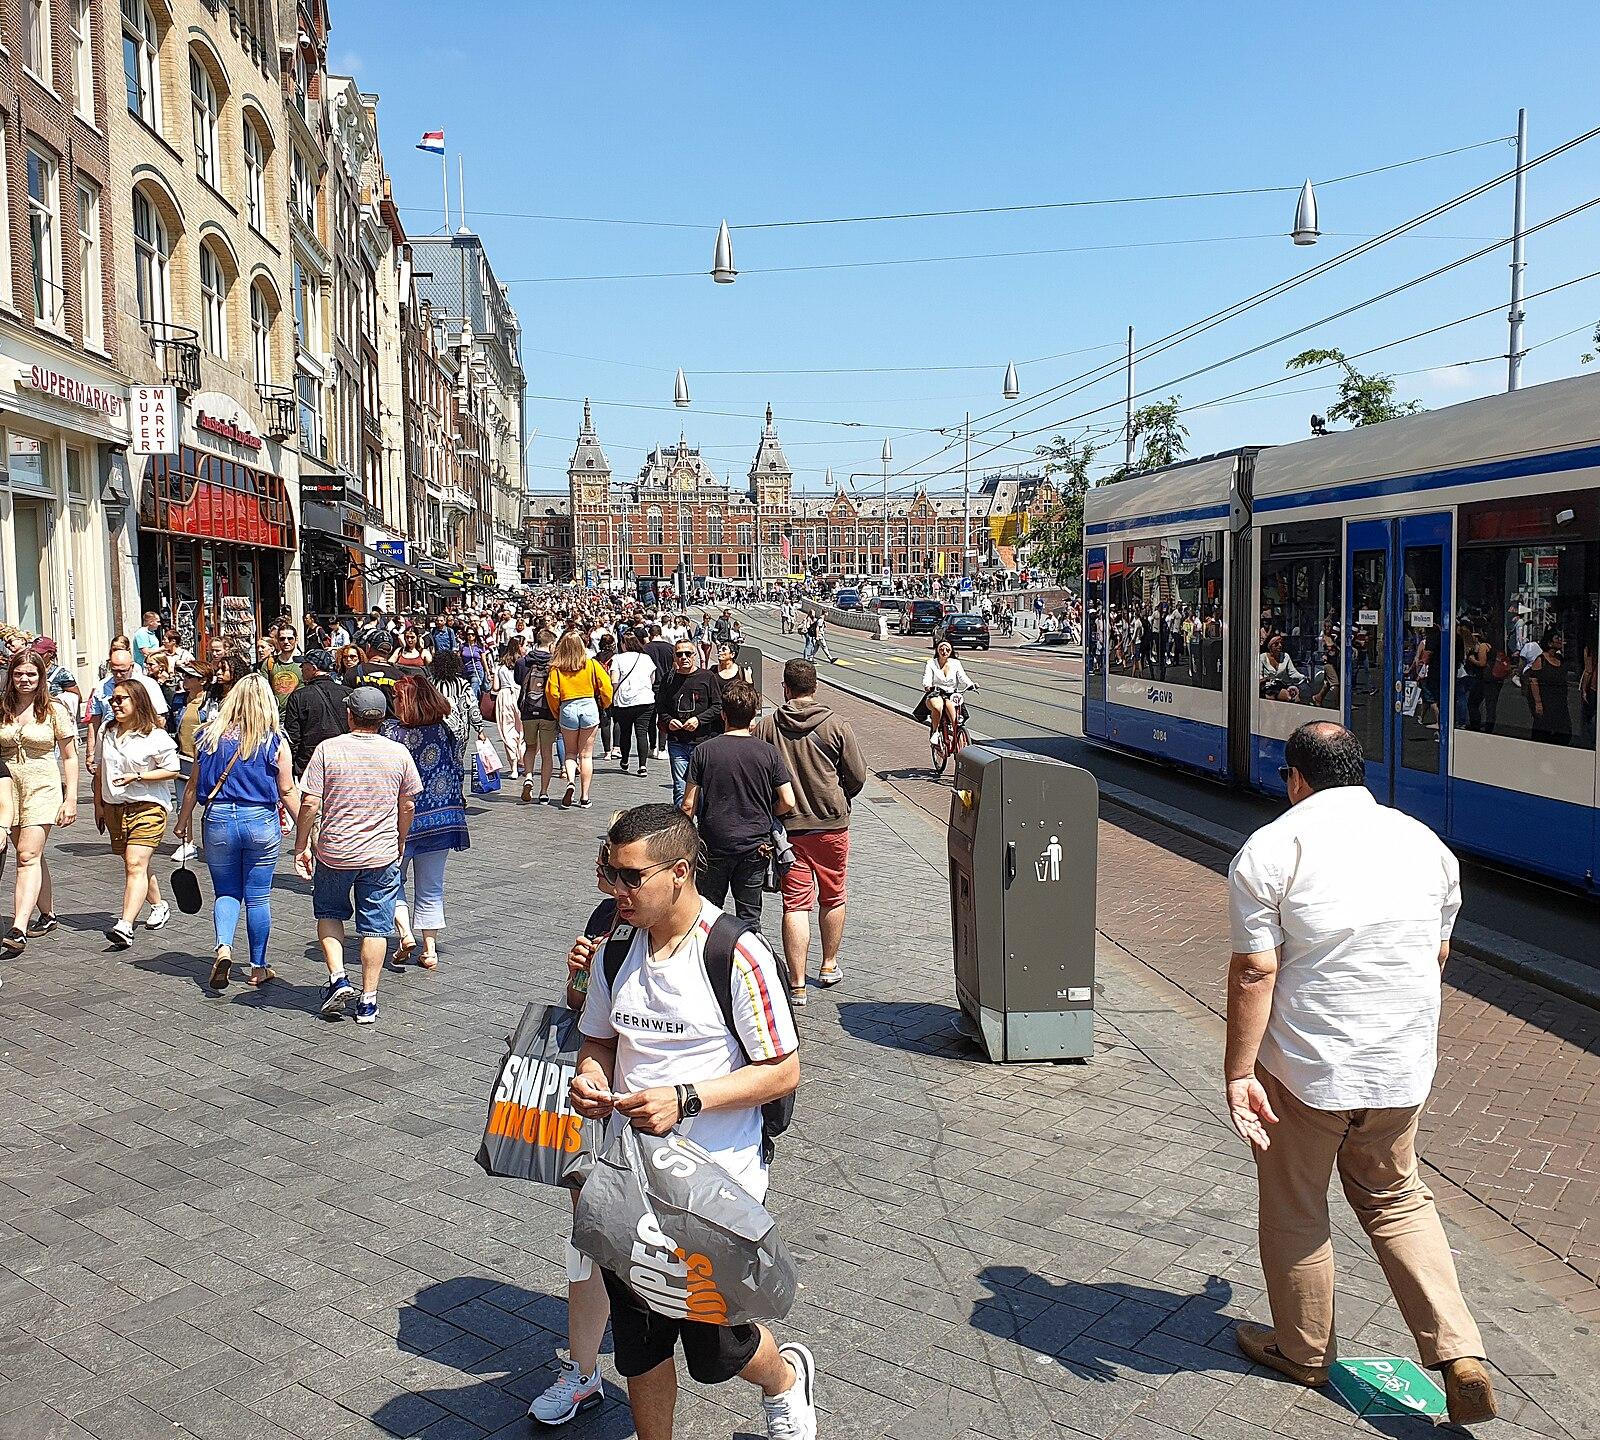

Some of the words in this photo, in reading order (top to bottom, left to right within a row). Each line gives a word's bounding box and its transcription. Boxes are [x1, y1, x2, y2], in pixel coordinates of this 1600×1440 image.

[32, 365, 123, 417] SUPERMARKET
[1413, 614, 1431, 622] Welkom
[1159, 690, 1173, 703] GVB
[1153, 729, 1167, 742] 2084
[615, 1011, 684, 1034] FERNWEH
[494, 1054, 583, 1120] SNIPE
[488, 1101, 583, 1153] KNOWS
